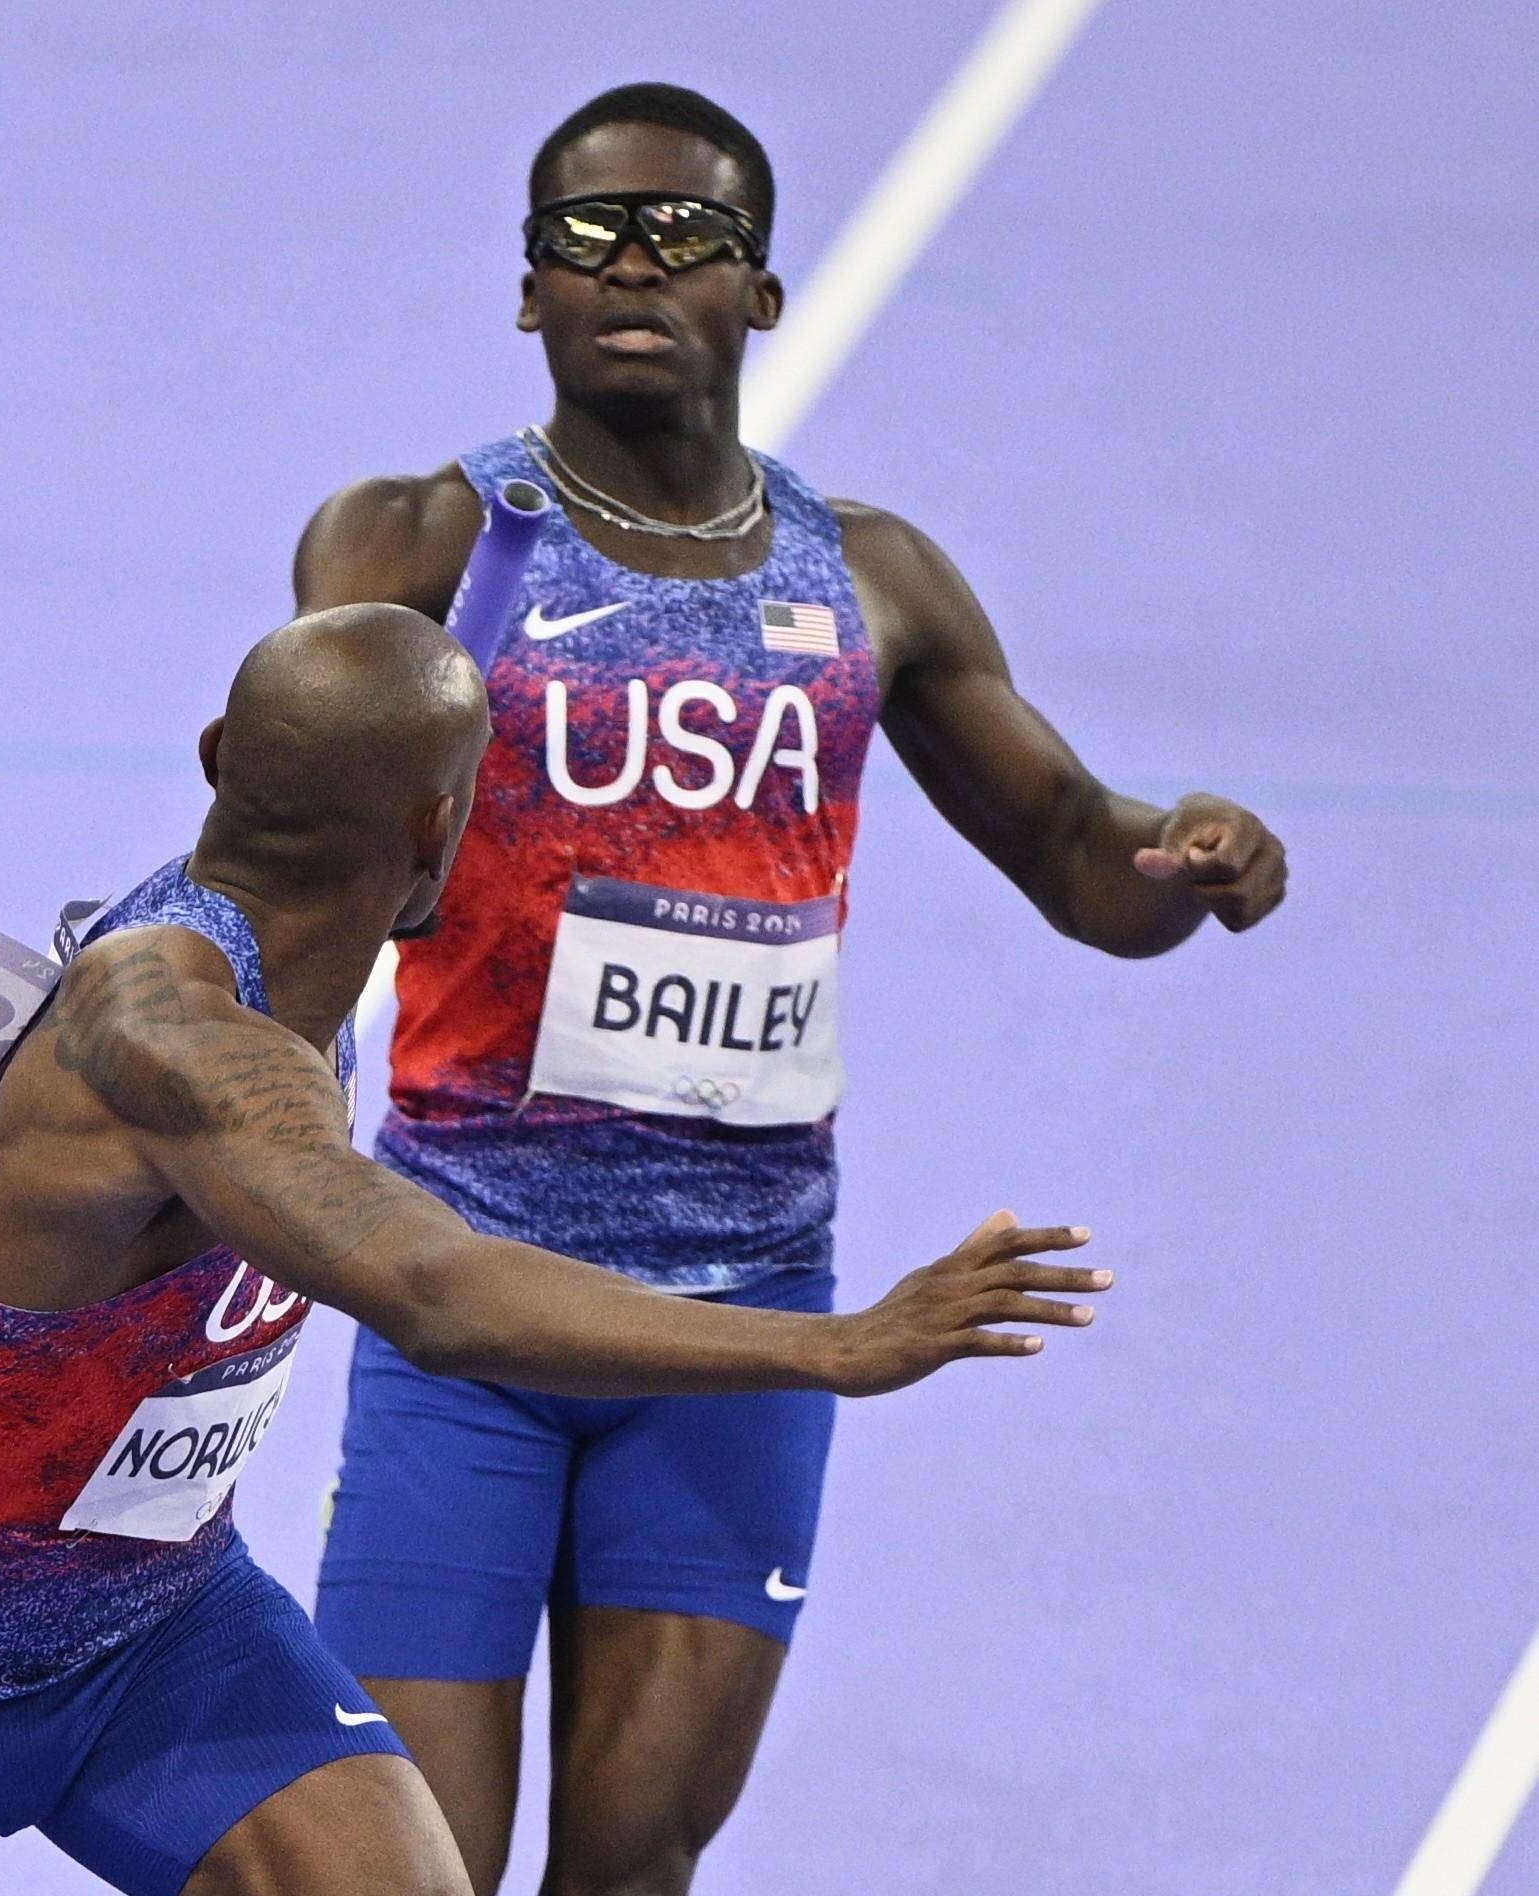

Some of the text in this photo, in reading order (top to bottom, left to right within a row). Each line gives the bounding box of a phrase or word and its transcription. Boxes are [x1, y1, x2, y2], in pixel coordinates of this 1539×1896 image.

[545, 679, 819, 814] USA
[653, 898, 738, 931] PARIS
[592, 962, 819, 1052] BAILEY
[222, 1346, 277, 1380] PARIS
